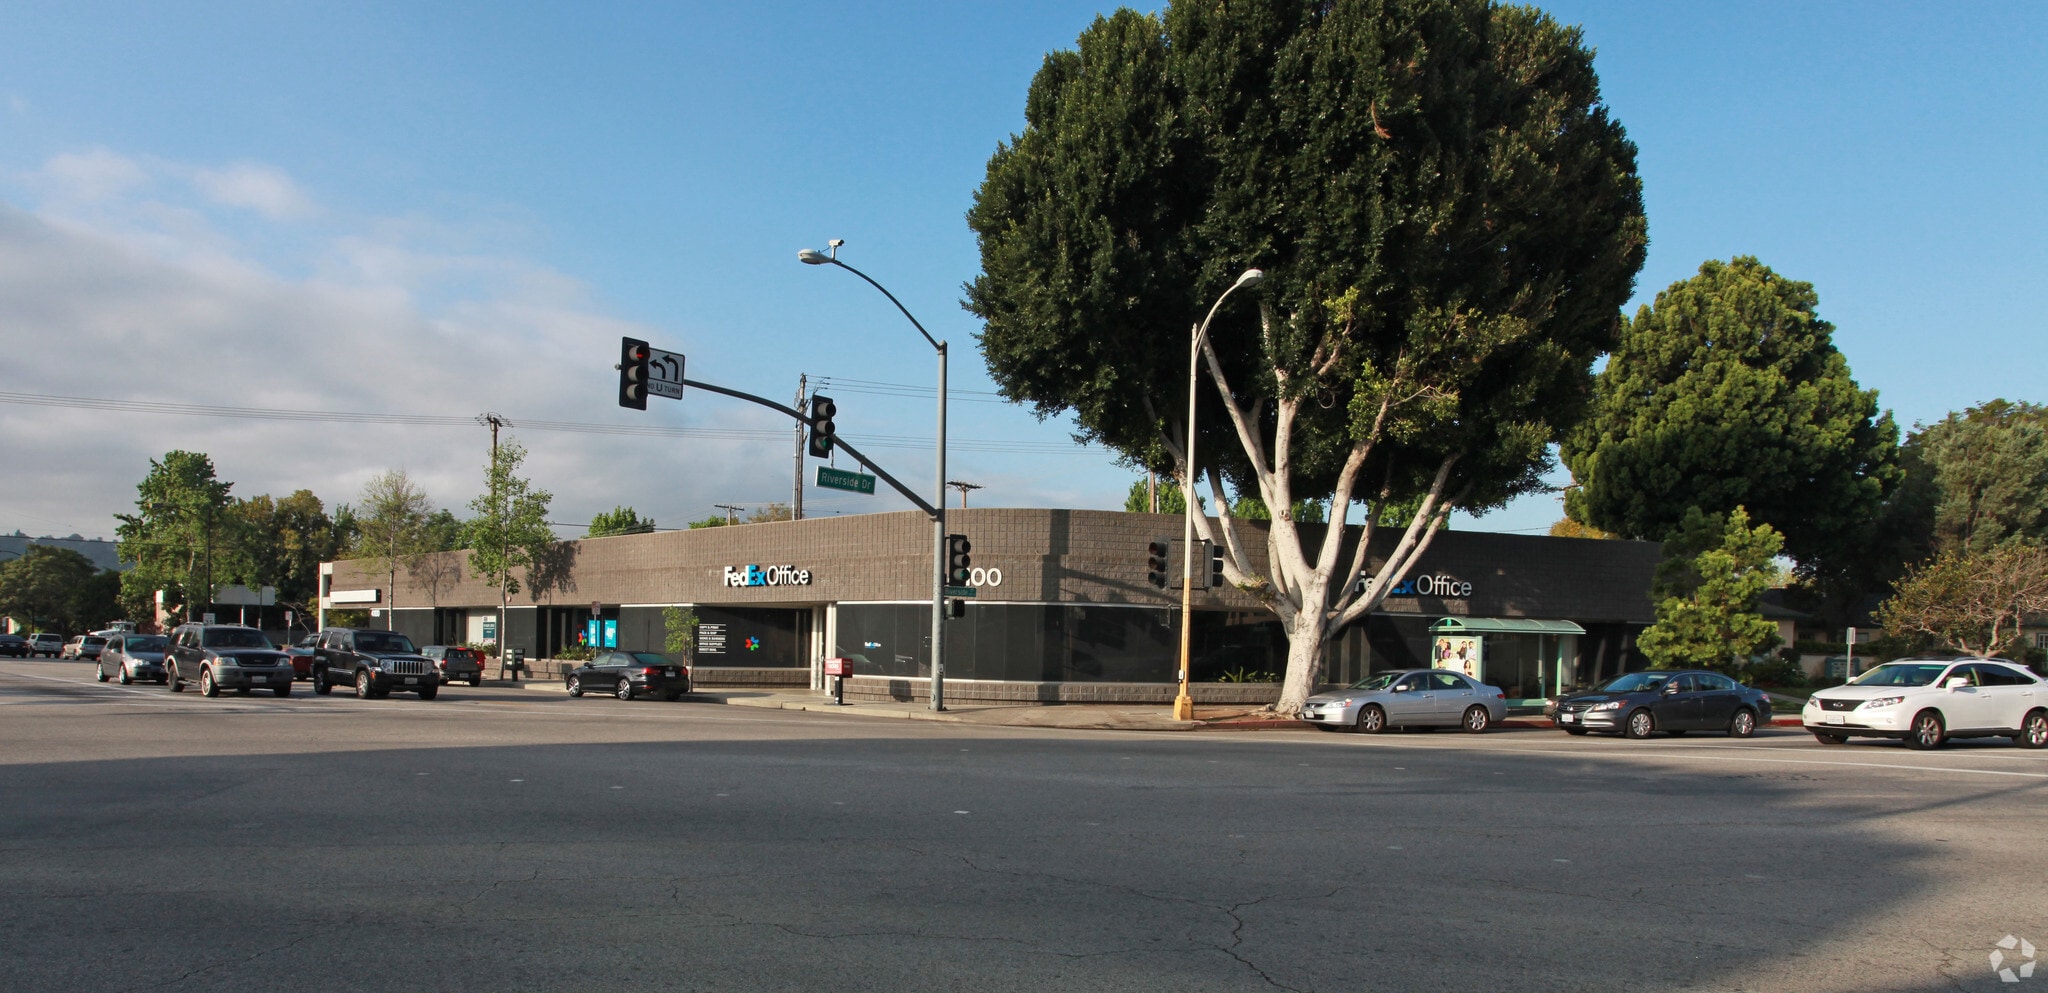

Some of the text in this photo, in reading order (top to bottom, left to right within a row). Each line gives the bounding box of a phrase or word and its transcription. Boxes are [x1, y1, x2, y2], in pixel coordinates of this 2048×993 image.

[656, 382, 663, 392] U
[664, 385, 680, 394] TURN
[821, 471, 871, 489] Riverside Dr
[1416, 574, 1473, 597] Office
